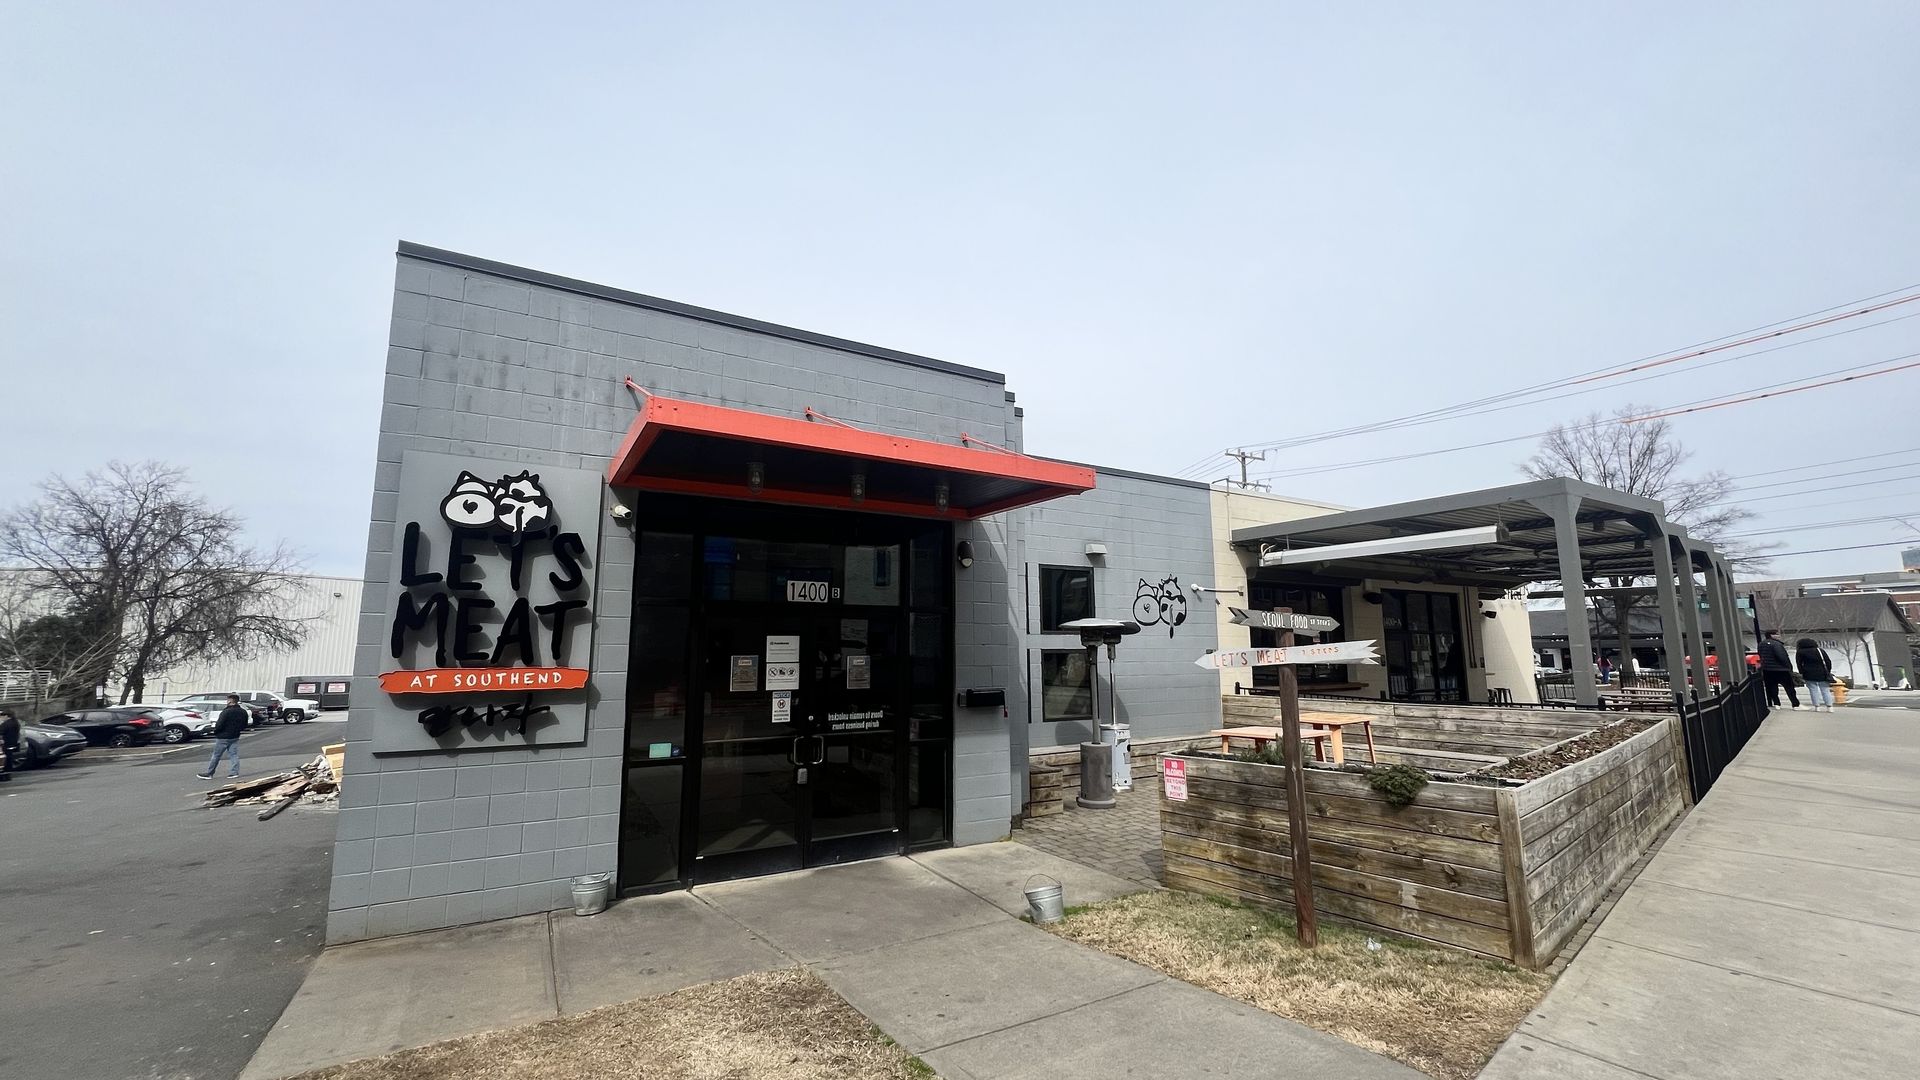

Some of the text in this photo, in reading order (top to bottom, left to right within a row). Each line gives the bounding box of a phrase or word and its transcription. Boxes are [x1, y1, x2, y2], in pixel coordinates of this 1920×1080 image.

[400, 522, 586, 591] LET'S
[790, 582, 840, 601] 1400 B
[391, 591, 588, 668] MEAT
[1261, 612, 1286, 628] SEOUL
[1290, 614, 1308, 629] FOOD
[1213, 652, 1248, 667] LET'S
[1256, 648, 1288, 664] MEAT
[1310, 646, 1339, 656] STEPS
[410, 671, 563, 688] AT SOUTHEND
